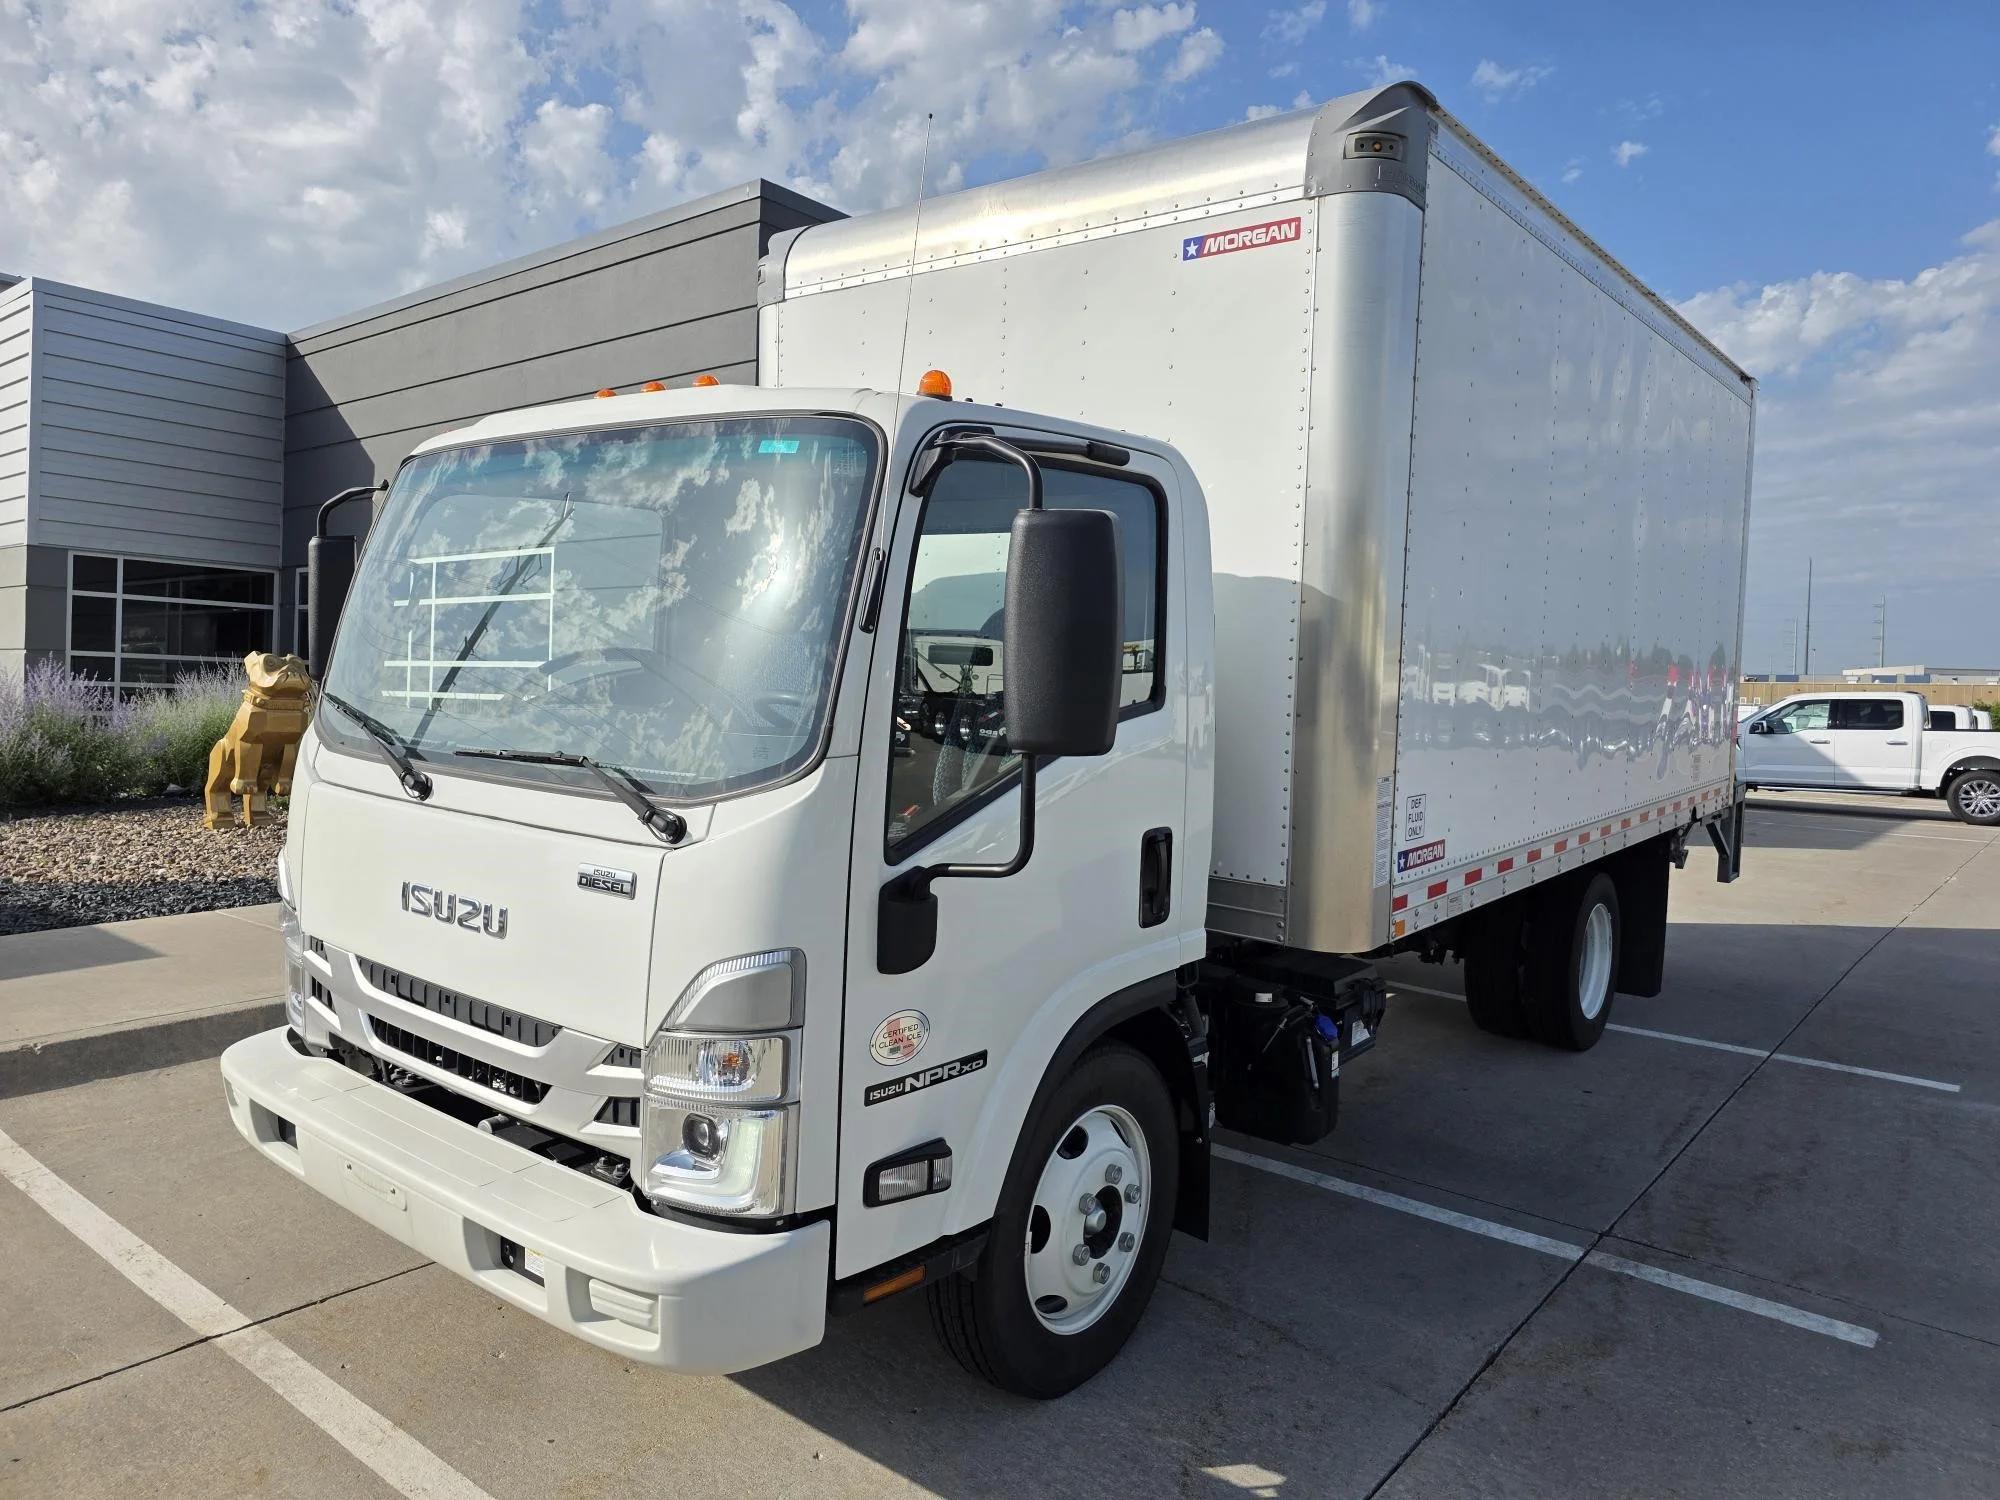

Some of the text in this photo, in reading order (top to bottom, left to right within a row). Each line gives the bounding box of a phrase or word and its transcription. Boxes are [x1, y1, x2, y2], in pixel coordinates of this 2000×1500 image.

[1203, 222, 1296, 254] MORGAN
[1411, 799, 1421, 809] DEF
[1408, 811, 1424, 823] FLUID
[1408, 825, 1423, 837] ONLY
[1407, 844, 1443, 867] MORGAN
[593, 869, 616, 879] ISUZU
[579, 875, 631, 895] DIESEL
[401, 880, 508, 939] ISUZU
[879, 1038, 903, 1048] CLEAN
[907, 1031, 921, 1041] IDLE
[883, 1024, 918, 1039] CERTIFIED
[870, 1083, 903, 1100] ISUZU
